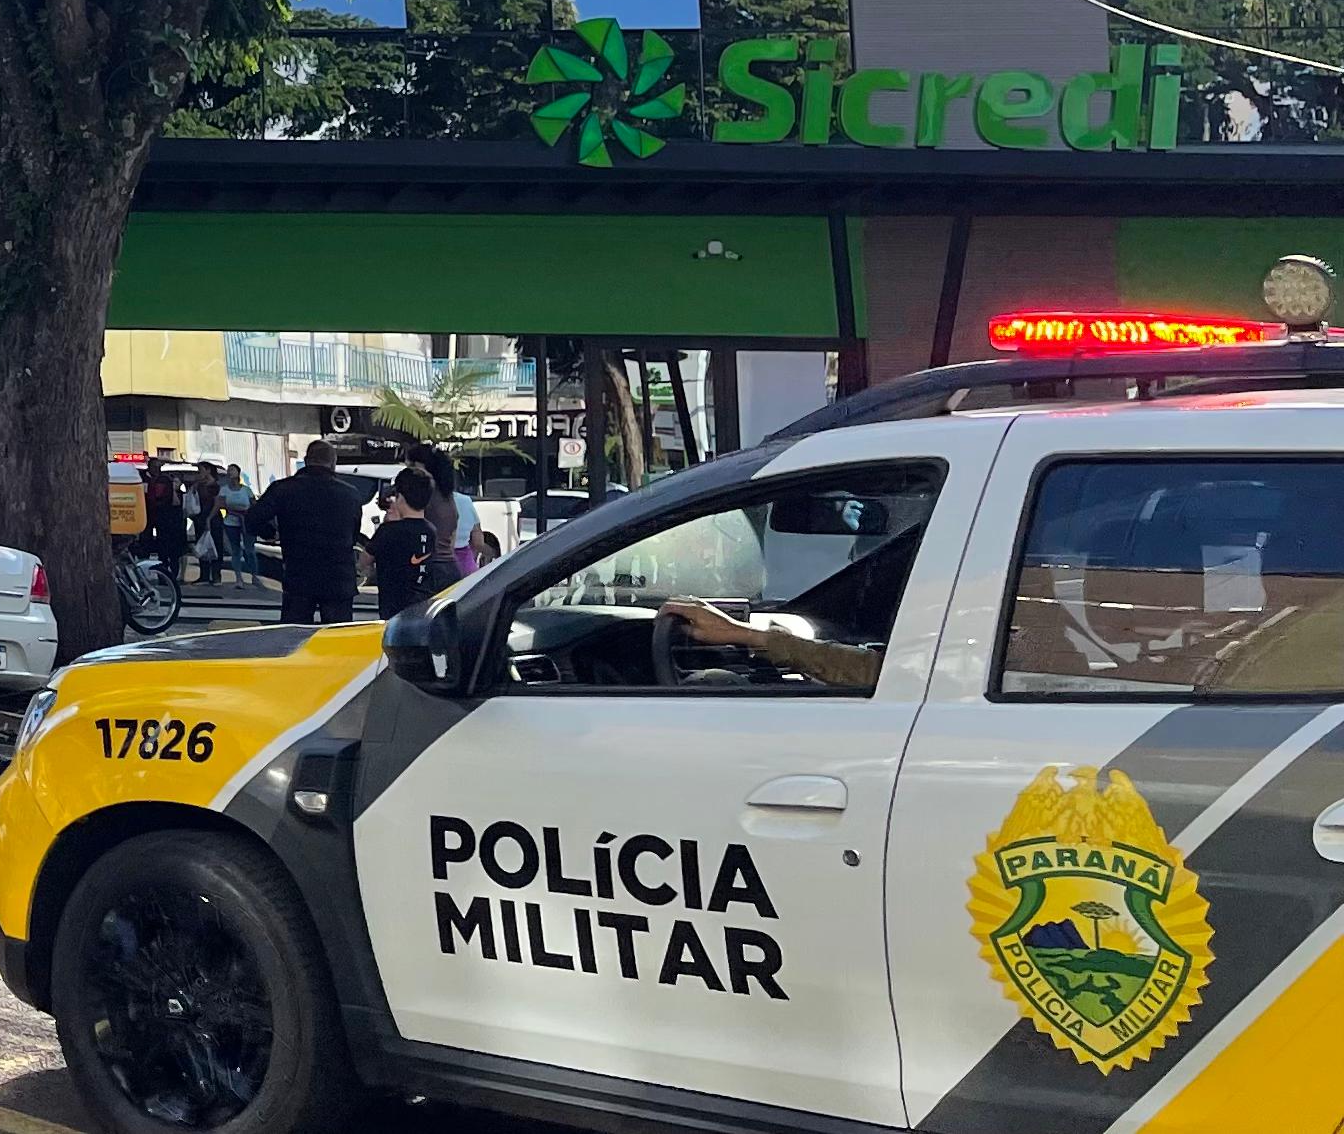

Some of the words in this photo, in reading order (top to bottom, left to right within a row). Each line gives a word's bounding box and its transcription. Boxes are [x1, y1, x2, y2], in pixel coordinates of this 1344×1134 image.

[713, 38, 1183, 151] Sicredi
[95, 718, 216, 763] 17826
[430, 815, 779, 919] POLÍCIA
[1006, 848, 1161, 889] PARANÁ
[434, 892, 790, 1001] MILITAR
[1109, 958, 1179, 1042] MILITAR
